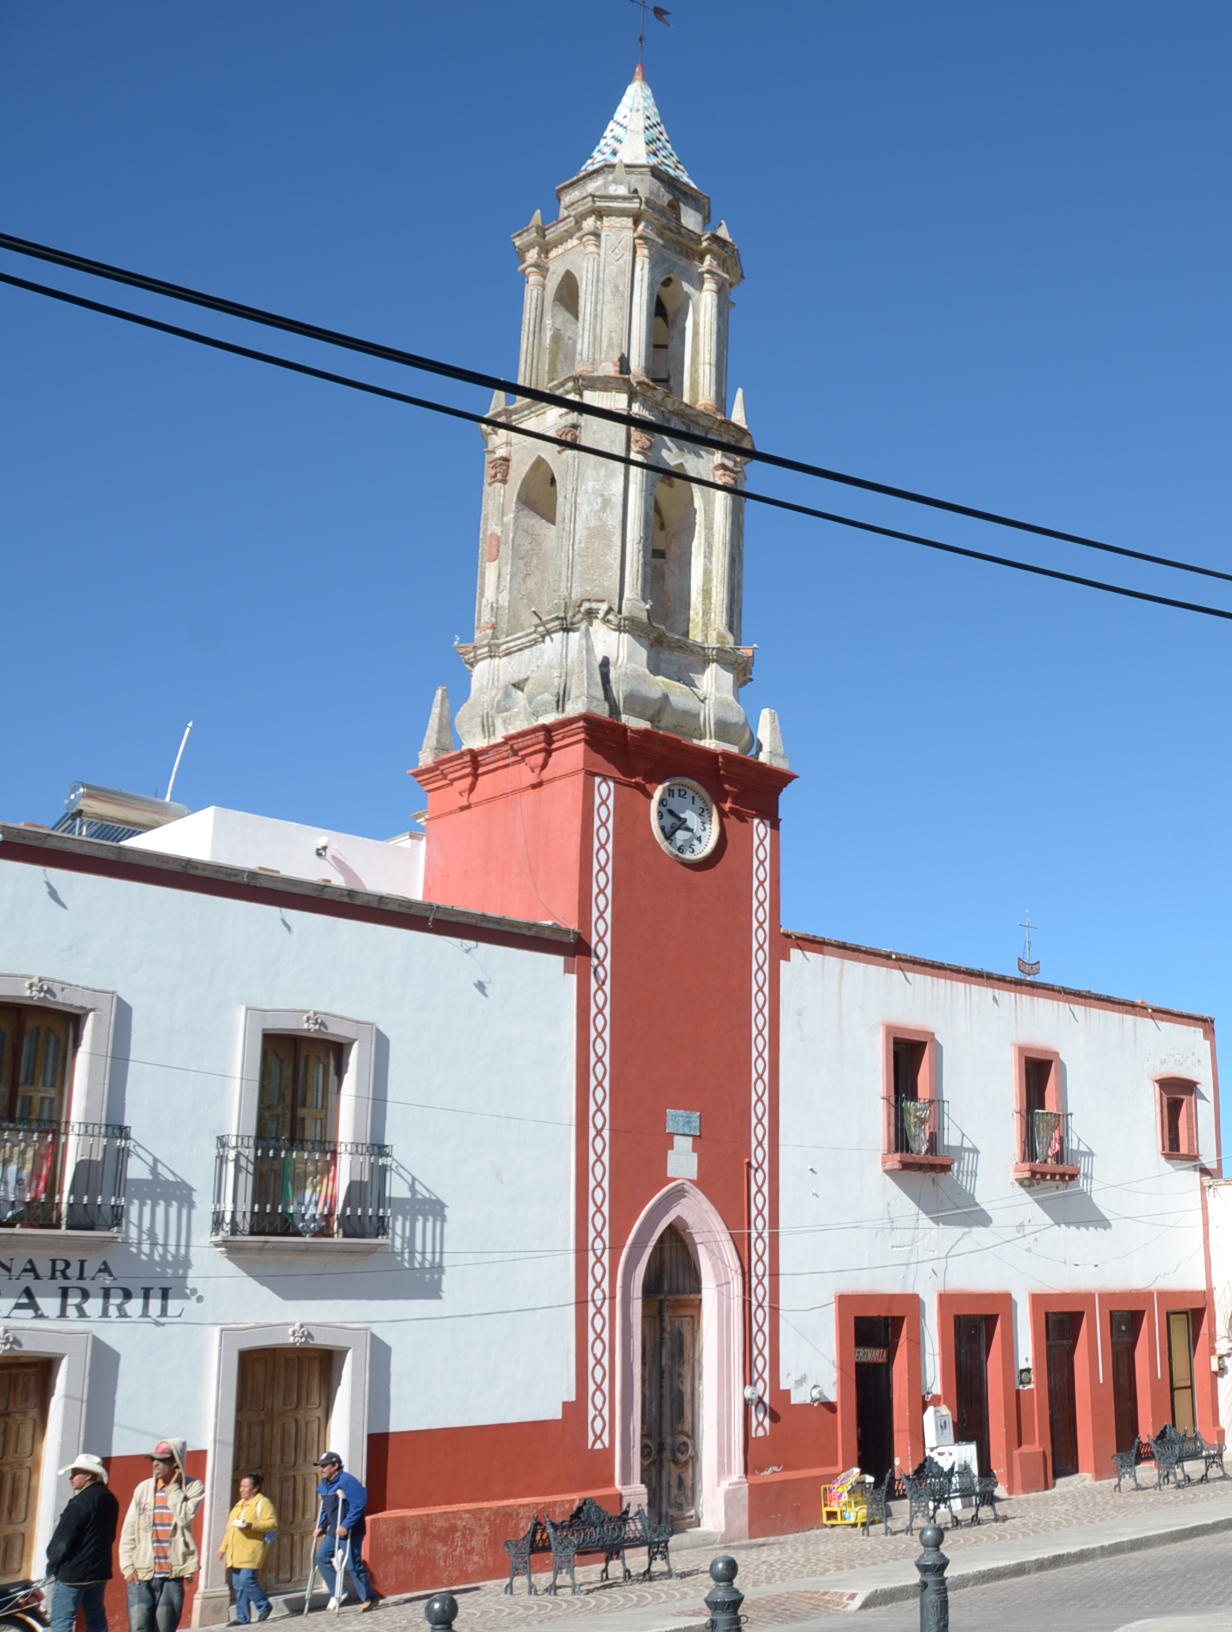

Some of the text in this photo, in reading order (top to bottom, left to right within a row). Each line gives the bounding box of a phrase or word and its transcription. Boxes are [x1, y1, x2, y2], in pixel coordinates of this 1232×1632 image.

[668, 788, 675, 798] 11
[678, 788, 687, 799] 12
[691, 795, 695, 805] 1
[699, 807, 705, 816] 2
[700, 821, 706, 831] 3
[696, 835, 702, 844] 4
[677, 845, 684, 853] 6
[689, 844, 695, 853] 5
[0, 1286, 185, 1319] ARRIL
